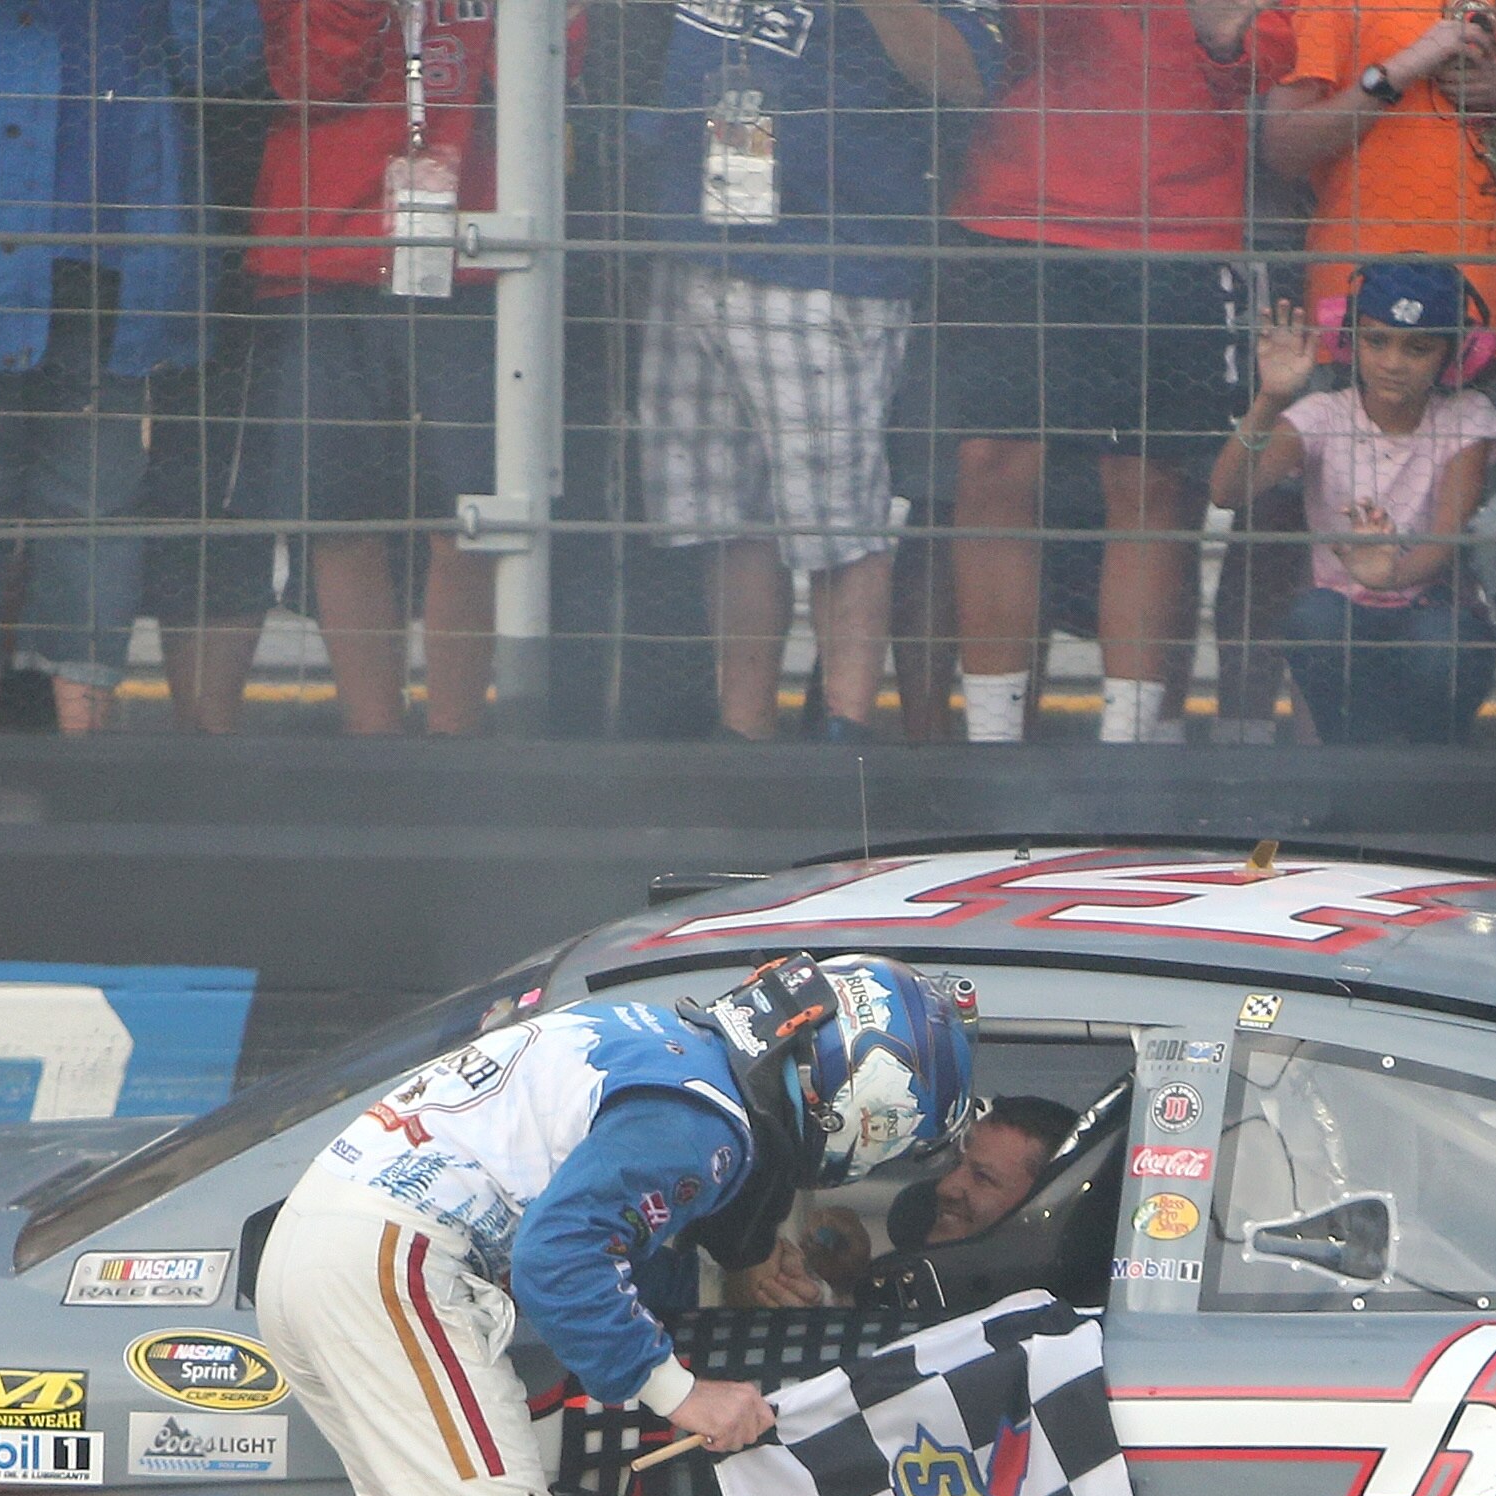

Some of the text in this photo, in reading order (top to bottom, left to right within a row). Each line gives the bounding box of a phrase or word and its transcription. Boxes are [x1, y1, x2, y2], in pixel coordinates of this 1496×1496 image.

[846, 975, 878, 1030] BUSCH
[127, 1259, 197, 1280] NASCAR
[1112, 1257, 1177, 1281] Mobil
[151, 1284, 204, 1298] CAR
[173, 1344, 234, 1360] NASCAR
[181, 1361, 239, 1383] Sprint
[218, 1391, 272, 1402] SERIES
[28, 1408, 83, 1429] WEAR
[219, 1437, 277, 1454] LIGHT
